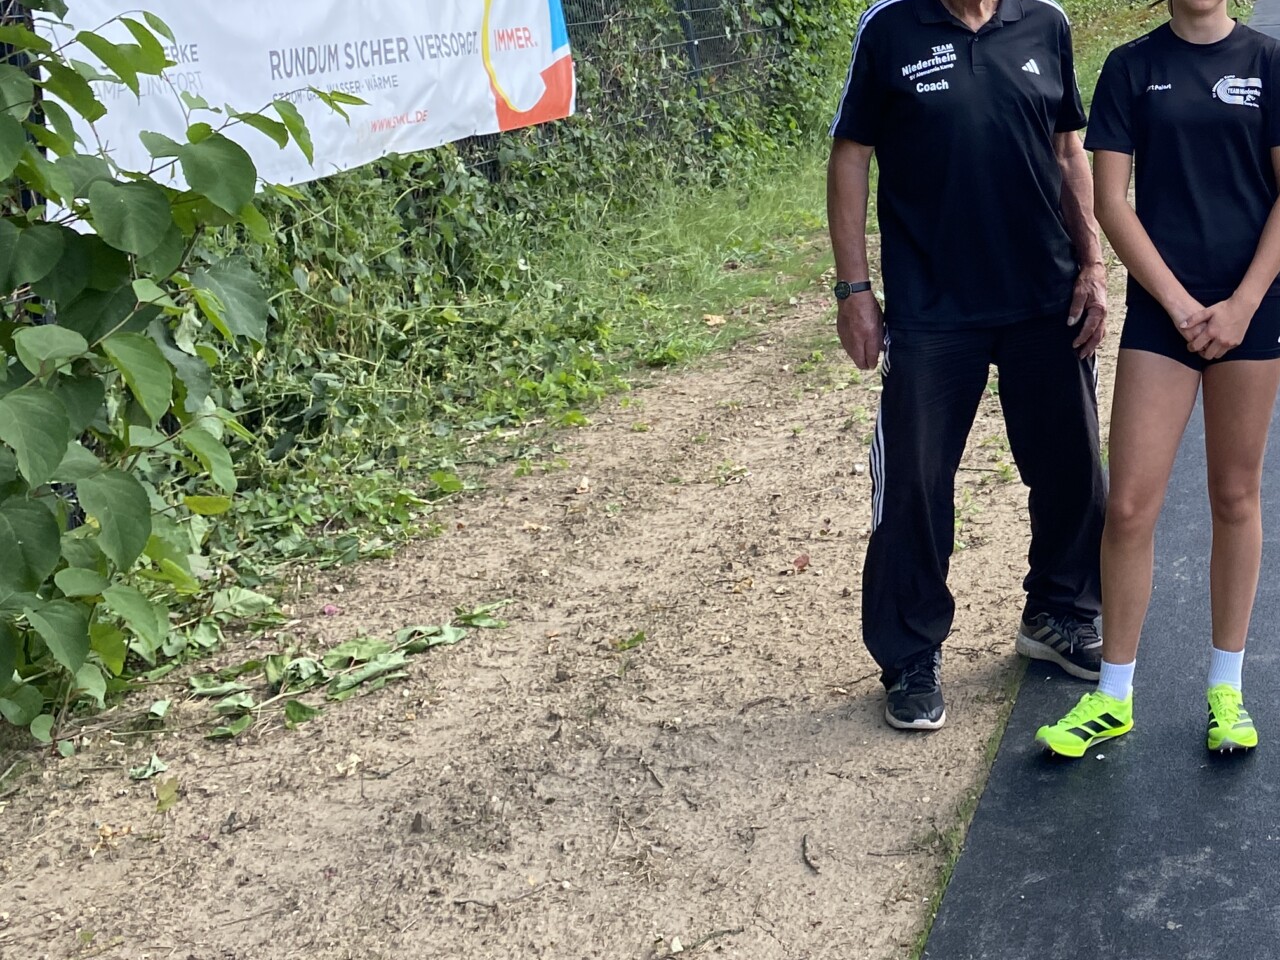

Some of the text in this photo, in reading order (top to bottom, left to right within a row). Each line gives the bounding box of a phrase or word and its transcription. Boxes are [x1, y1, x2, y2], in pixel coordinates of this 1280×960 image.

[269, 43, 340, 80] RUNDUM
[344, 37, 410, 70] SICHER
[493, 26, 539, 52] IMMER.
[931, 43, 954, 53] TEAM
[901, 53, 957, 76] Niederrhein
[916, 79, 949, 93] Coach
